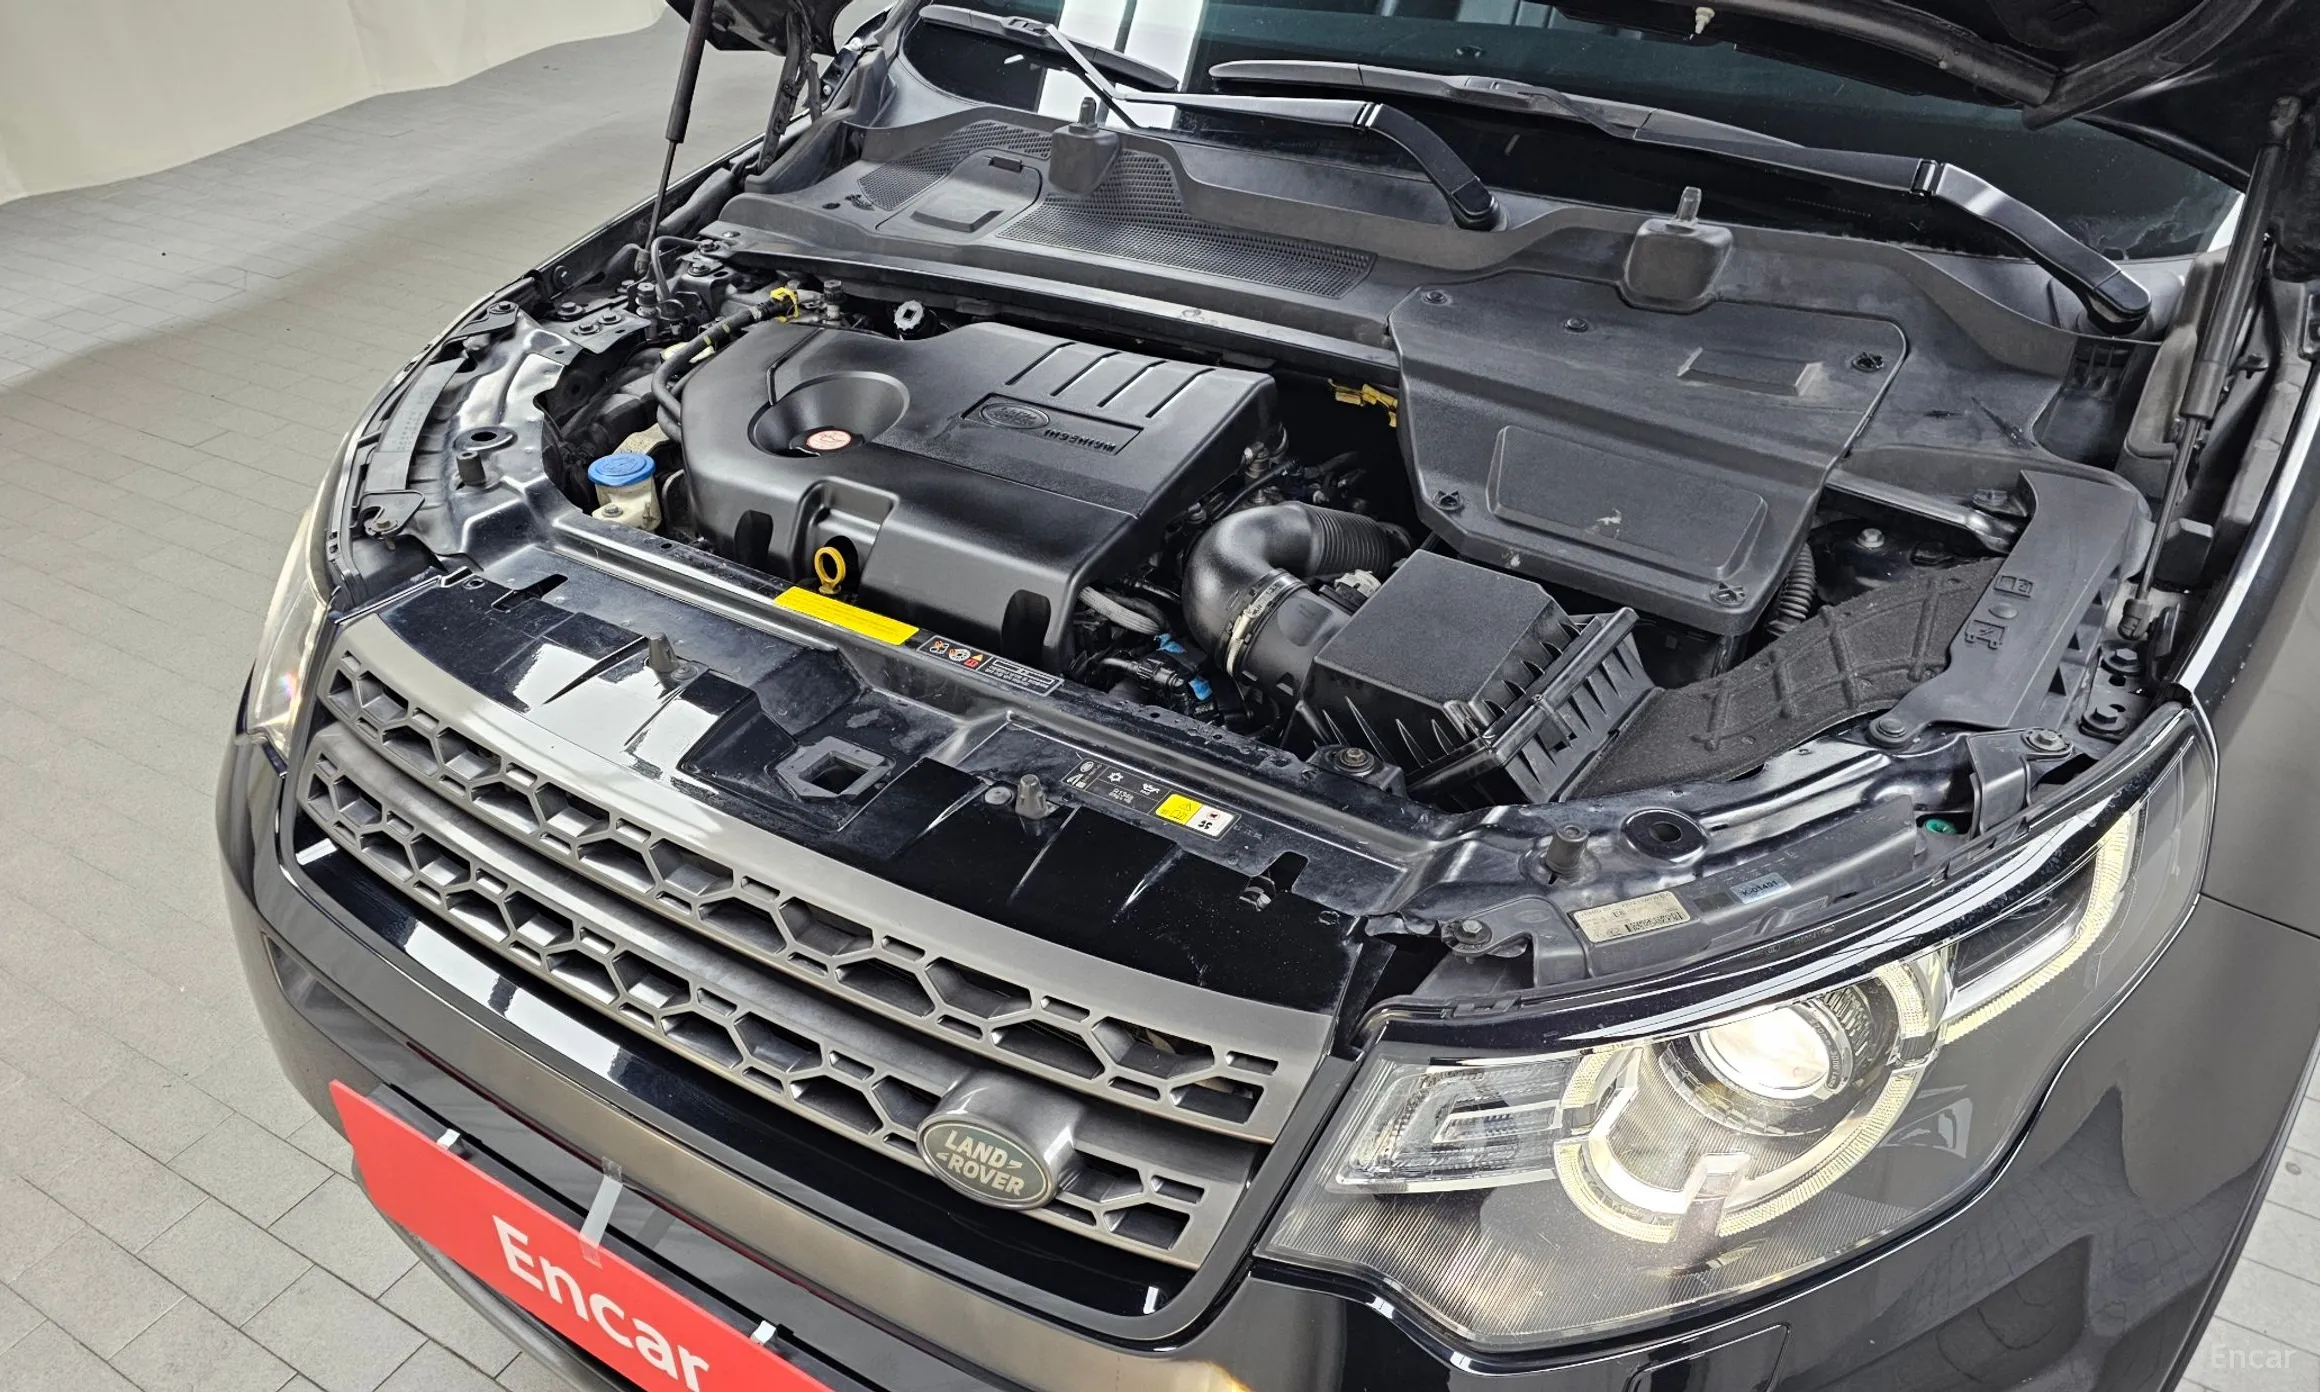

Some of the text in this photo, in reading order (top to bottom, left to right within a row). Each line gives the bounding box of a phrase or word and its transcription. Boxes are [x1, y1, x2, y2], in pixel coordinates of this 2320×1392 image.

[944, 1129, 1008, 1169] LAND
[947, 1153, 1025, 1196] ROVER
[492, 1214, 710, 1392] Encar
